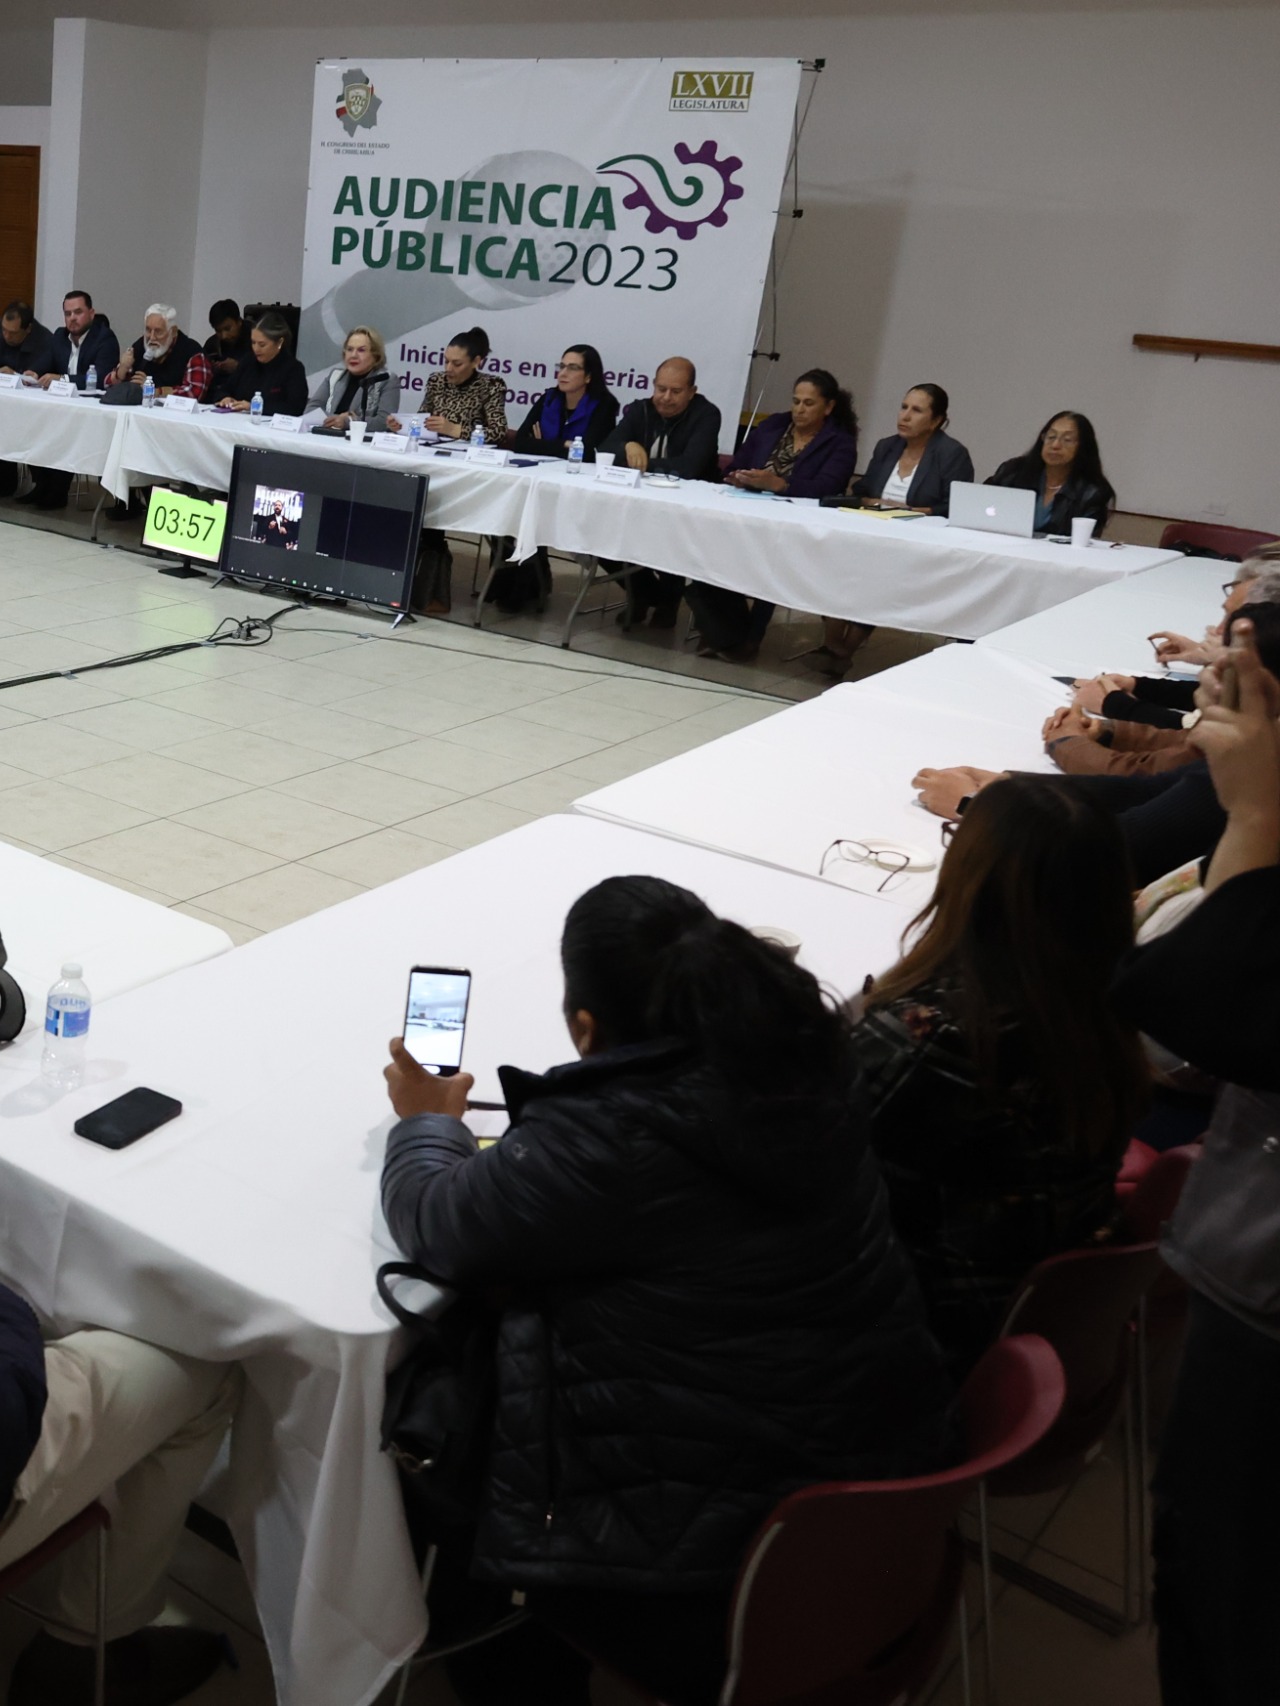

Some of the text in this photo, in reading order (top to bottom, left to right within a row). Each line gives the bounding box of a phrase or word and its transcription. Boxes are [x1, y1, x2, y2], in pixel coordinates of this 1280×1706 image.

[675, 73, 752, 96] LXVII
[672, 99, 745, 110] LEGISLATURA
[357, 141, 367, 149] DEL
[332, 175, 617, 231] AUDIENCIA
[331, 219, 679, 292] PÚBLICA 2023
[518, 360, 547, 378] en
[399, 370, 424, 392] de
[153, 505, 216, 542] 03:57
